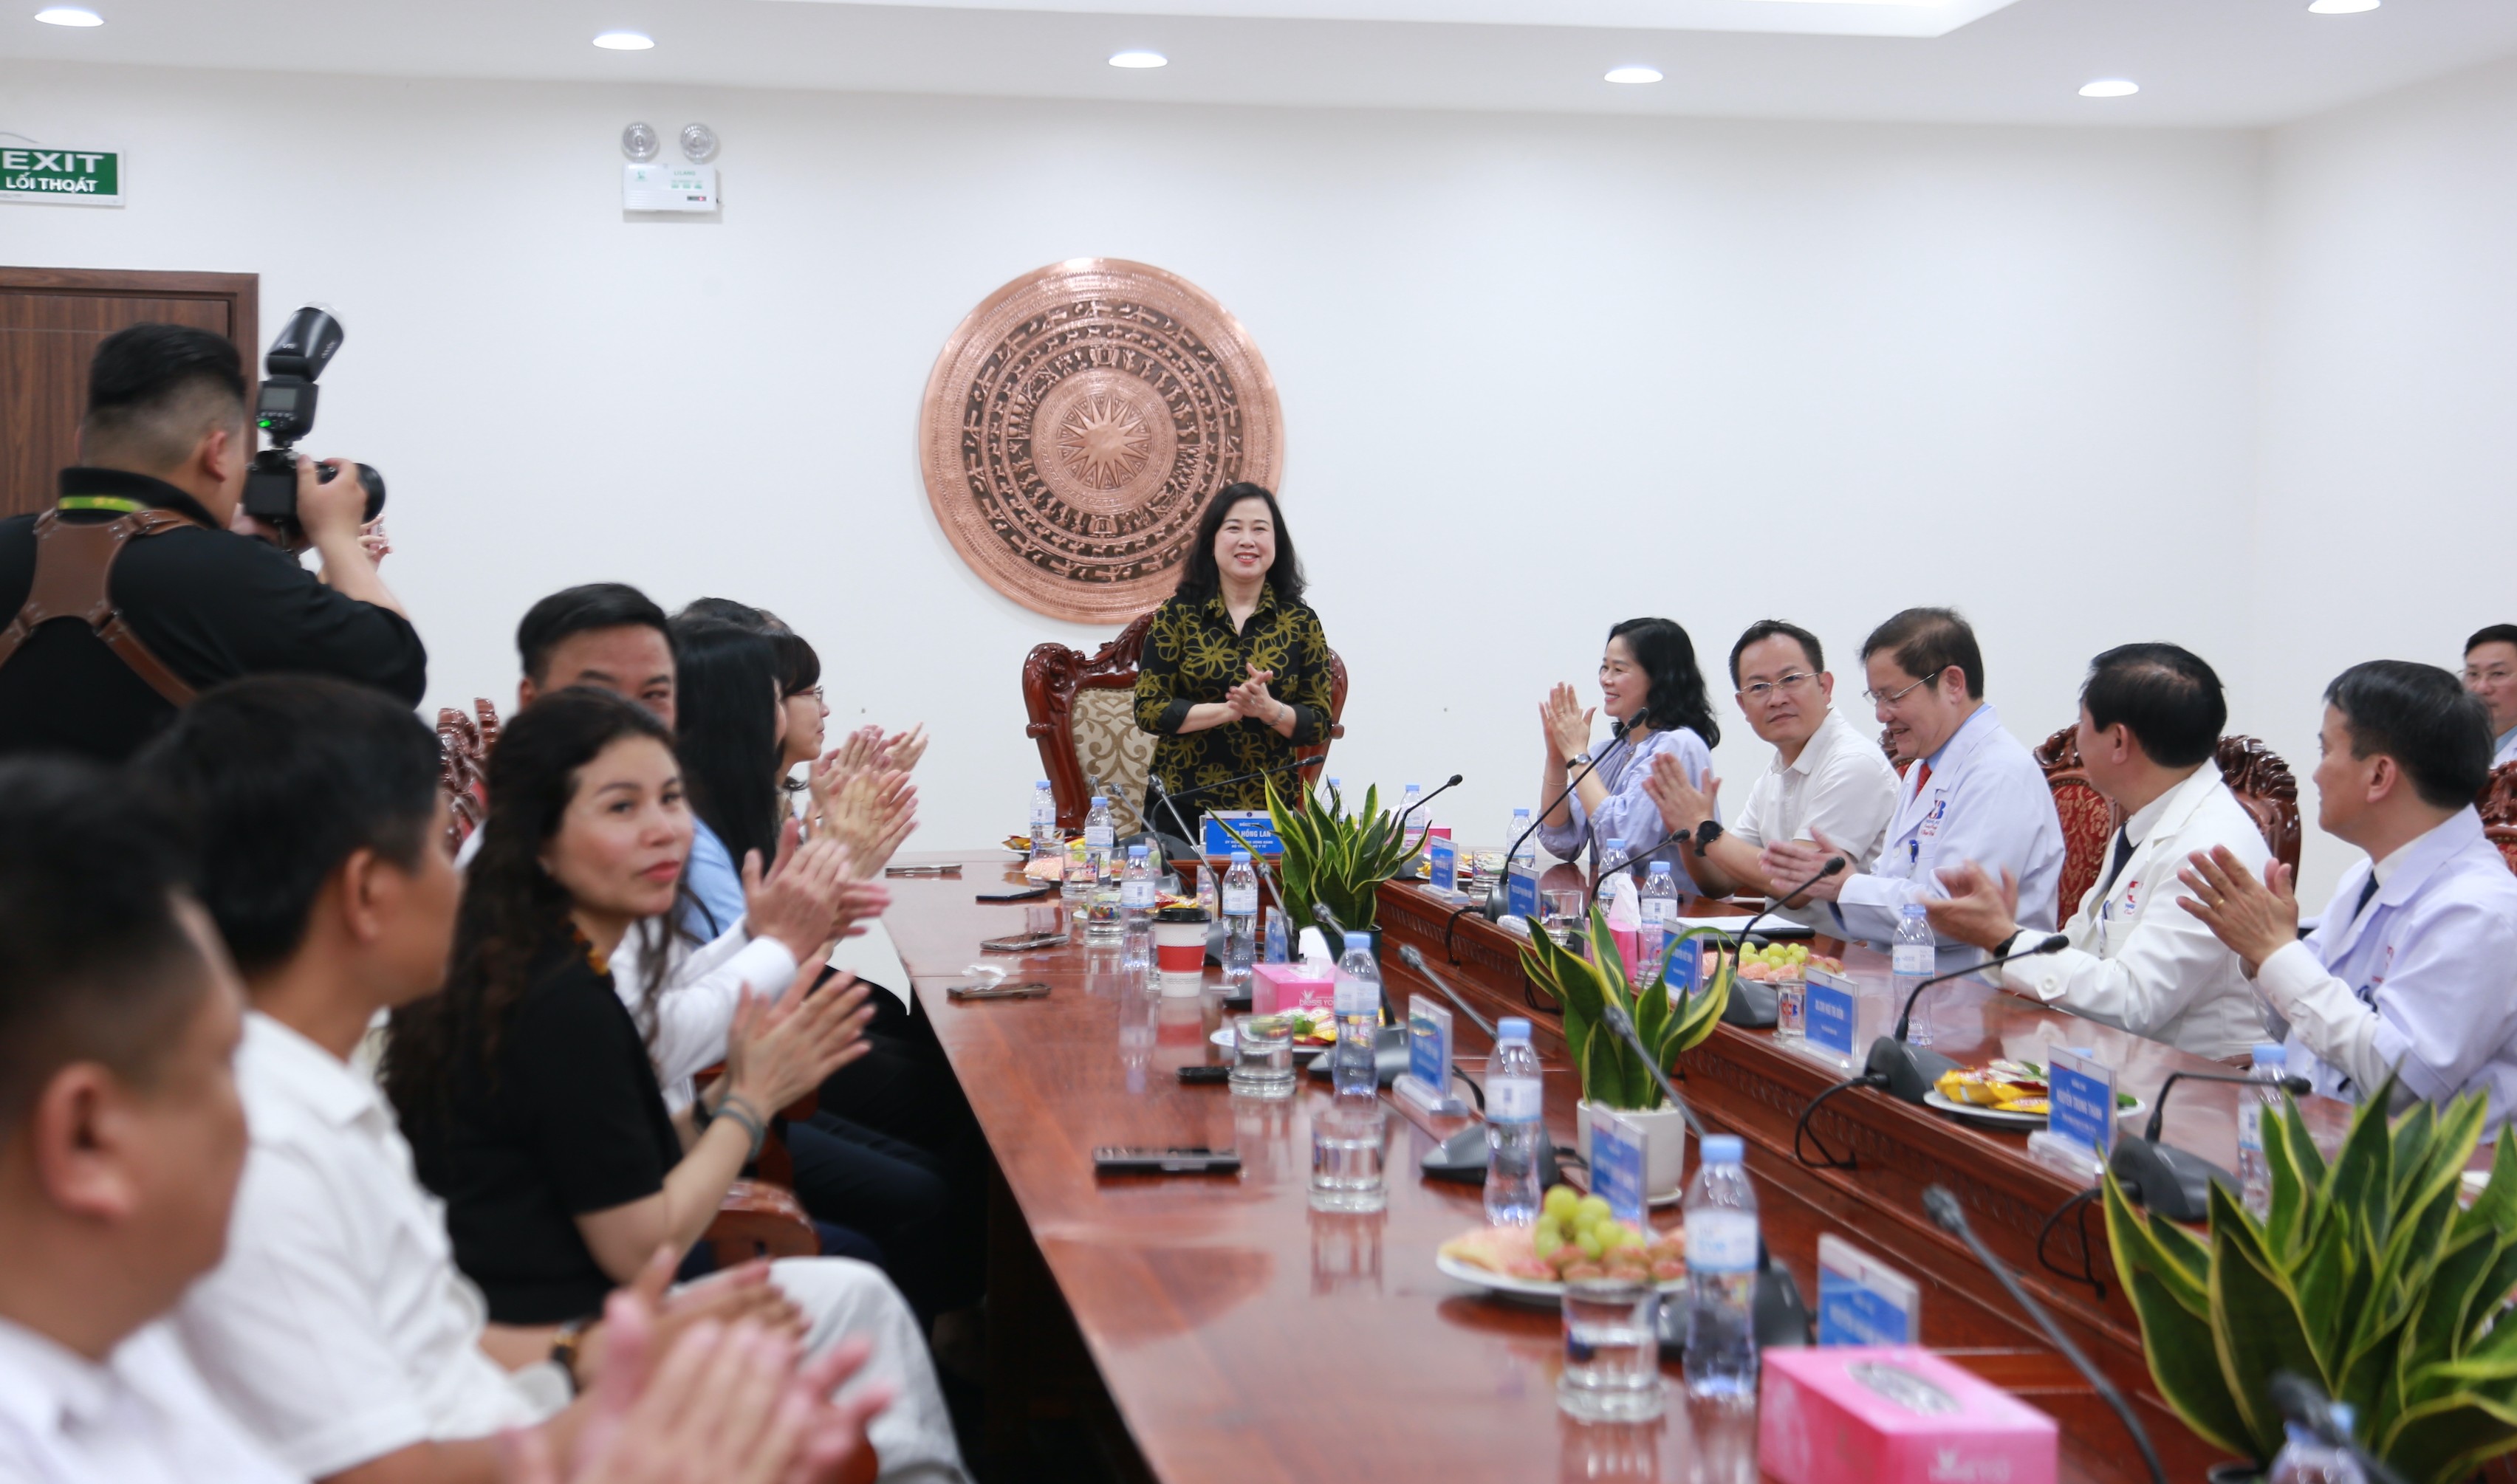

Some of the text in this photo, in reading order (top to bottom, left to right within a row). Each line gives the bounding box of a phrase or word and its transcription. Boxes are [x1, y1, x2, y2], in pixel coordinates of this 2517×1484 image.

[2, 151, 104, 173] EXIT
[6, 172, 35, 190] LỐI
[1299, 998, 1322, 1006] bless
